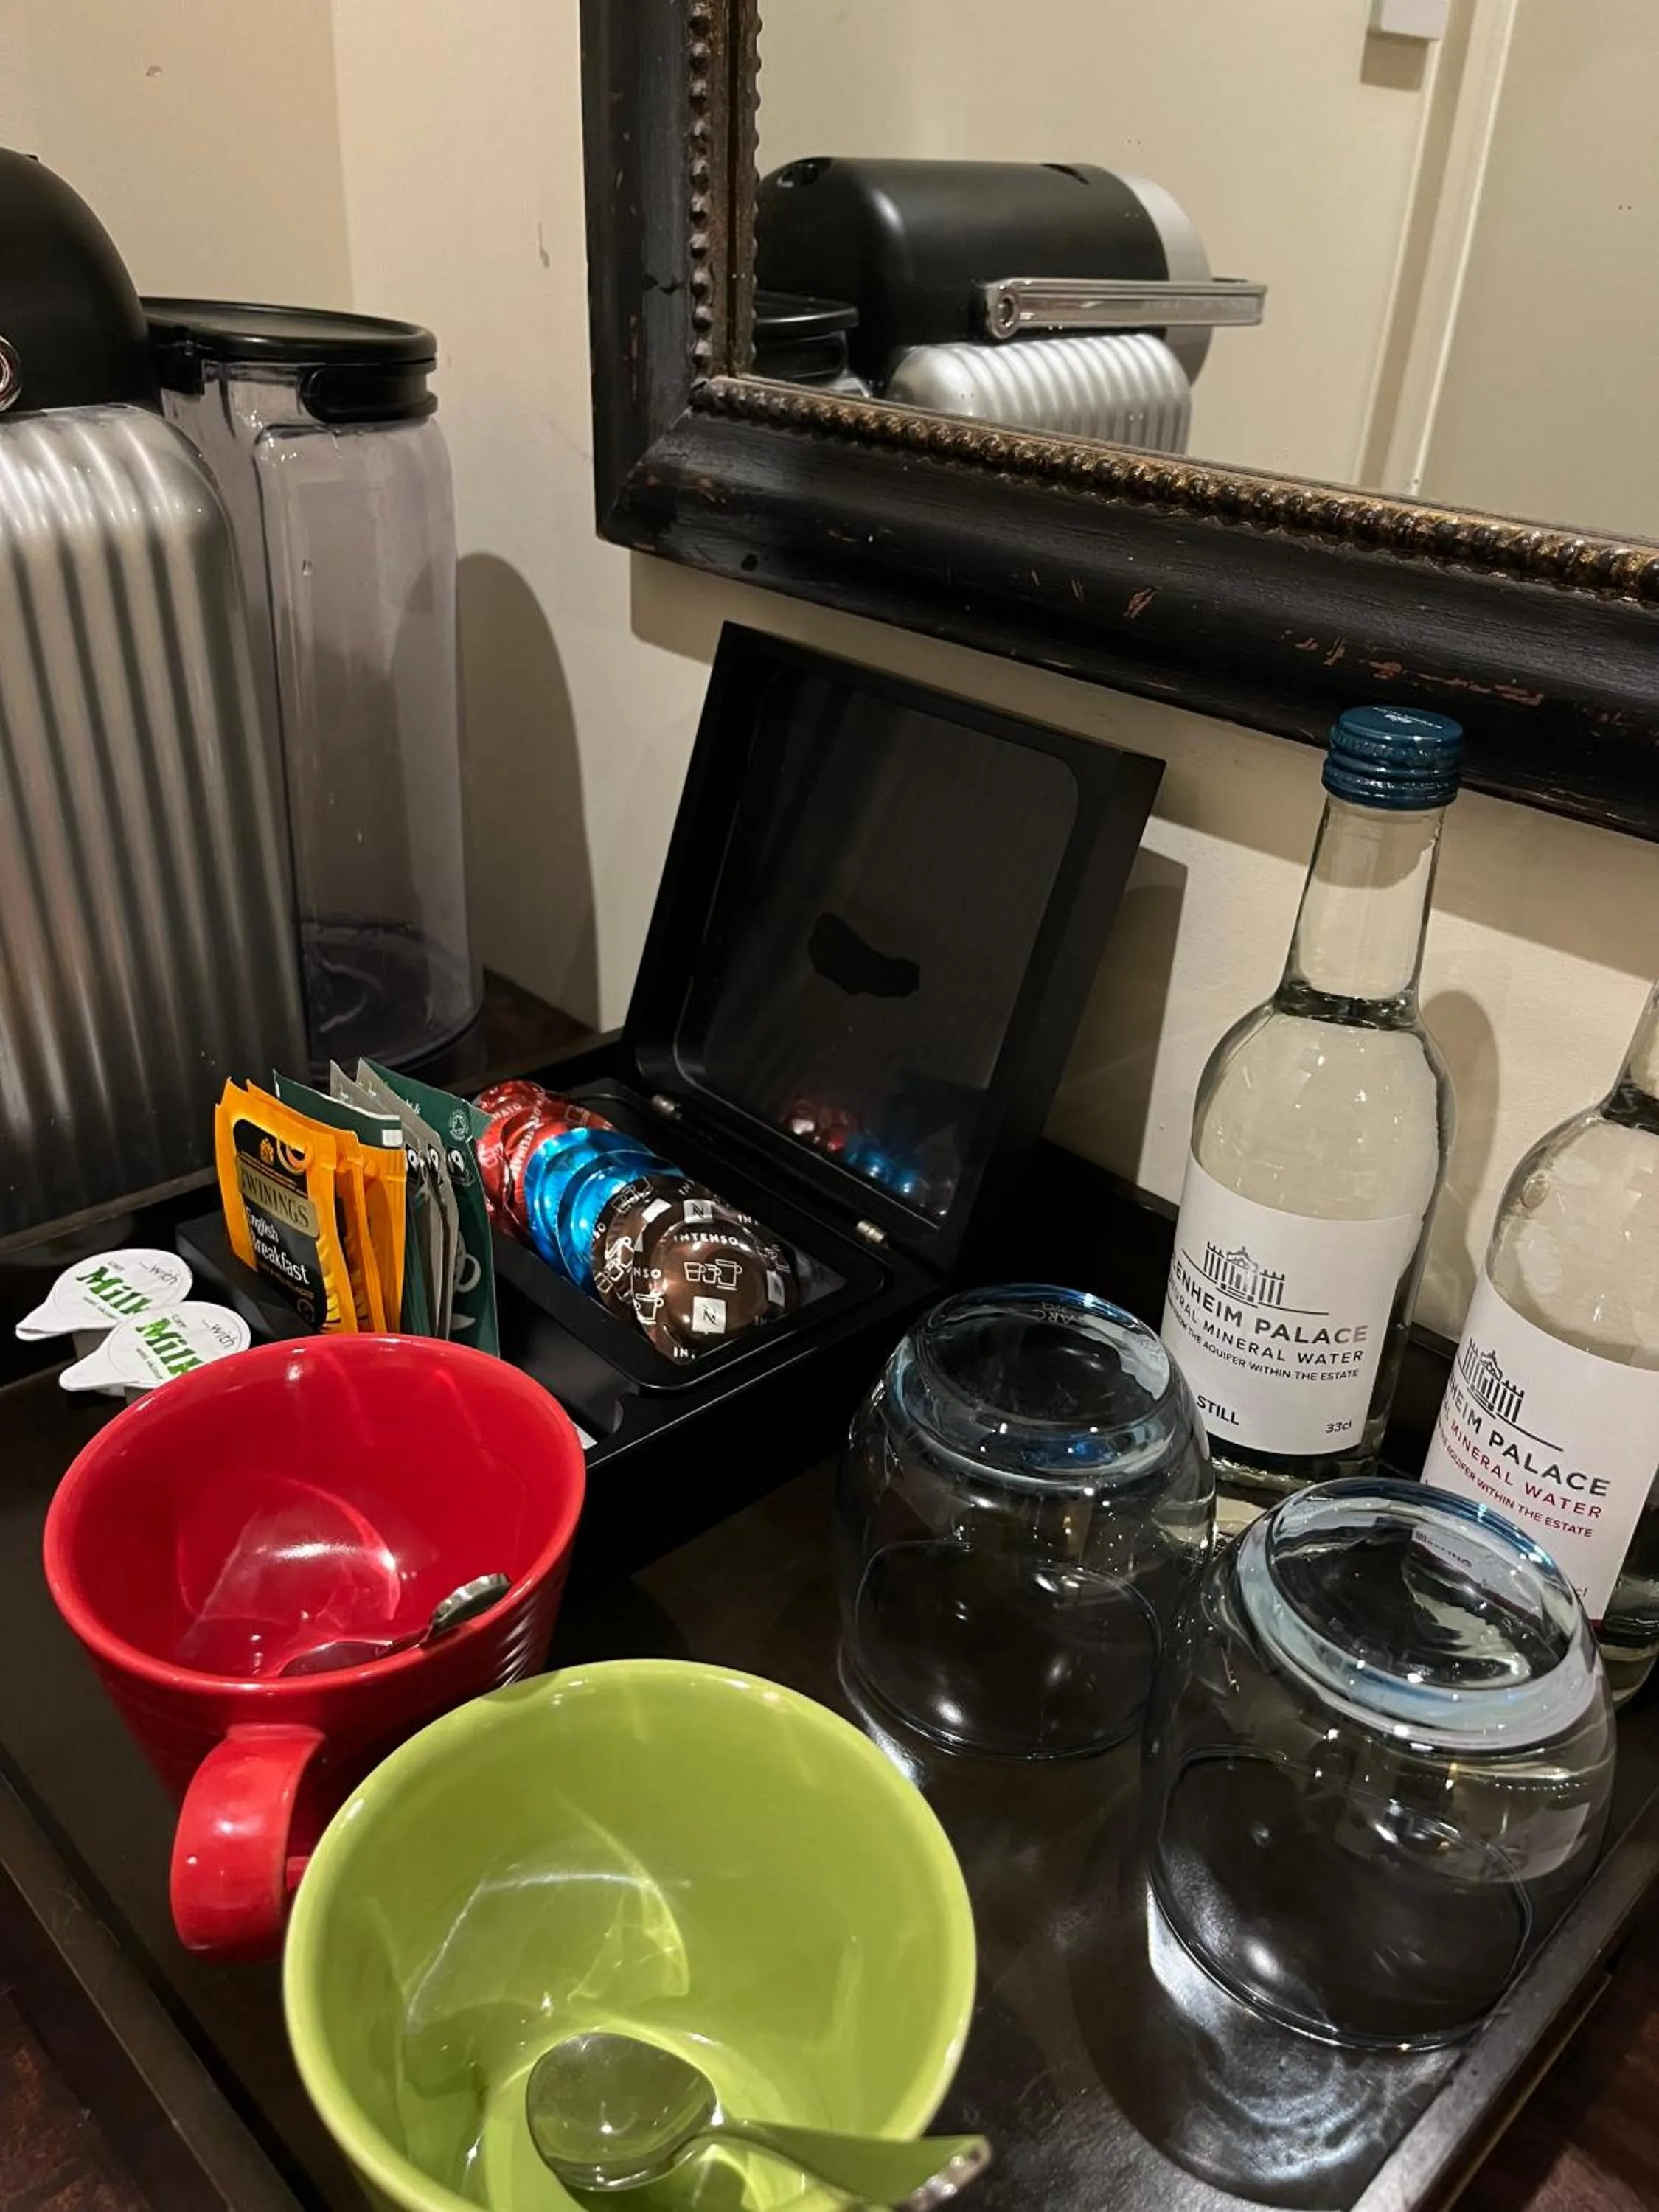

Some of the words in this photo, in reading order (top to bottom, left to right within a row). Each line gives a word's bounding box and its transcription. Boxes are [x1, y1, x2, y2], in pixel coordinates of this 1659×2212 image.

[674, 1232, 737, 1246] INTENSO
[76, 1266, 153, 1315] Milk
[1173, 1260, 1242, 1327] ENHEIM
[1255, 1318, 1368, 1344] PALACE
[1203, 1320, 1286, 1362] MINERAL
[1298, 1350, 1363, 1364] WATER
[1203, 1341, 1246, 1367] AQUIFER
[1248, 1361, 1291, 1378] WITHIN
[1295, 1371, 1318, 1381] THE
[1321, 1368, 1358, 1381] ESTATE
[1197, 1395, 1239, 1425] STILL
[1326, 1419, 1352, 1433] 33cl
[1451, 1419, 1513, 1486] MINERAL
[1526, 1482, 1602, 1519] WATER
[1489, 1430, 1610, 1497] PALACE
[1477, 1477, 1516, 1509] WITHIN
[1518, 1503, 1543, 1522] THE
[1545, 1517, 1593, 1537] ESTATE
